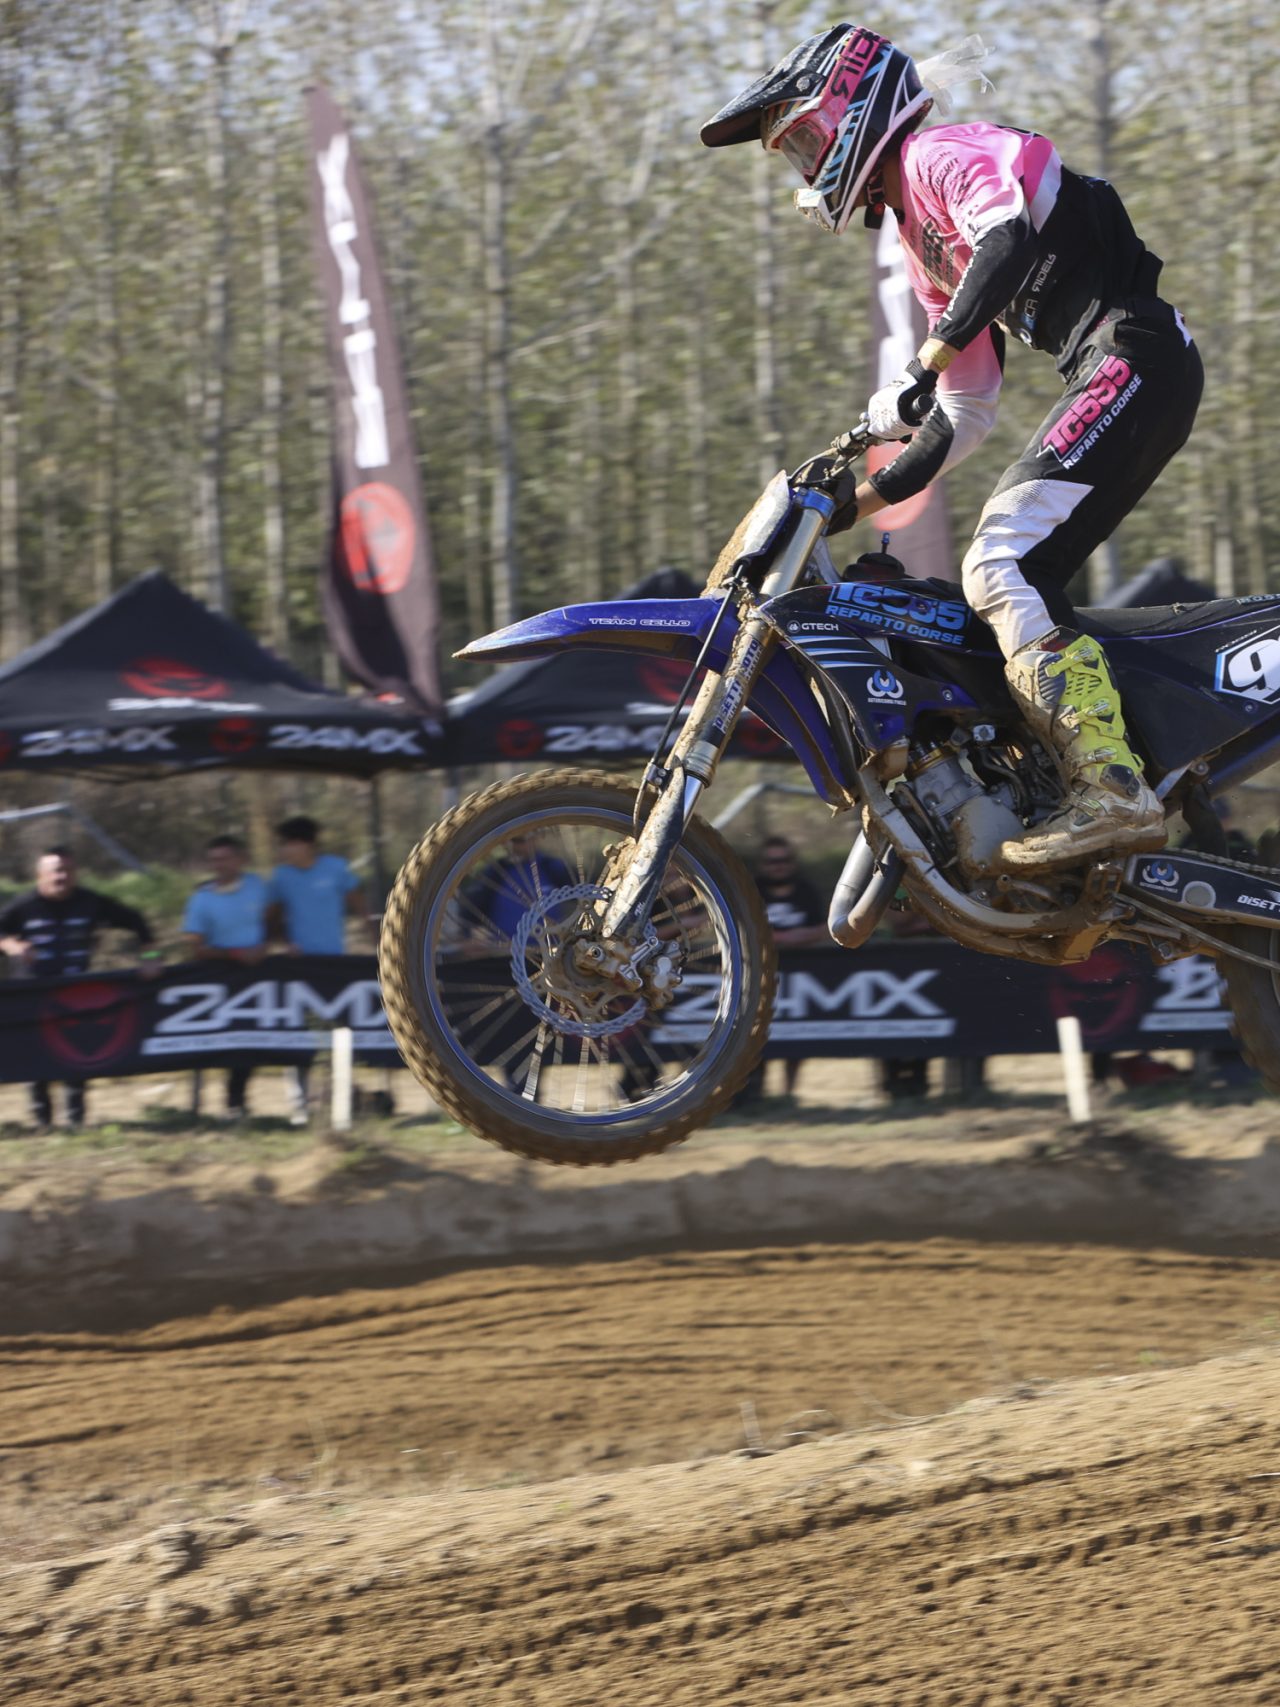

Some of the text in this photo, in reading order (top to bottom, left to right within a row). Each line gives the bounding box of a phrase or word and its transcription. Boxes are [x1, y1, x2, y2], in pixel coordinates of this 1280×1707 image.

[1063, 373, 1143, 471] REPARTO CORSE
[588, 616, 691, 627] TEAM CELLO
[801, 622, 840, 632] GTECH
[825, 604, 965, 646] REPARTO CORSE
[18, 724, 177, 757] 24MX
[267, 723, 425, 755] 24MX
[154, 980, 388, 1034] 24M
